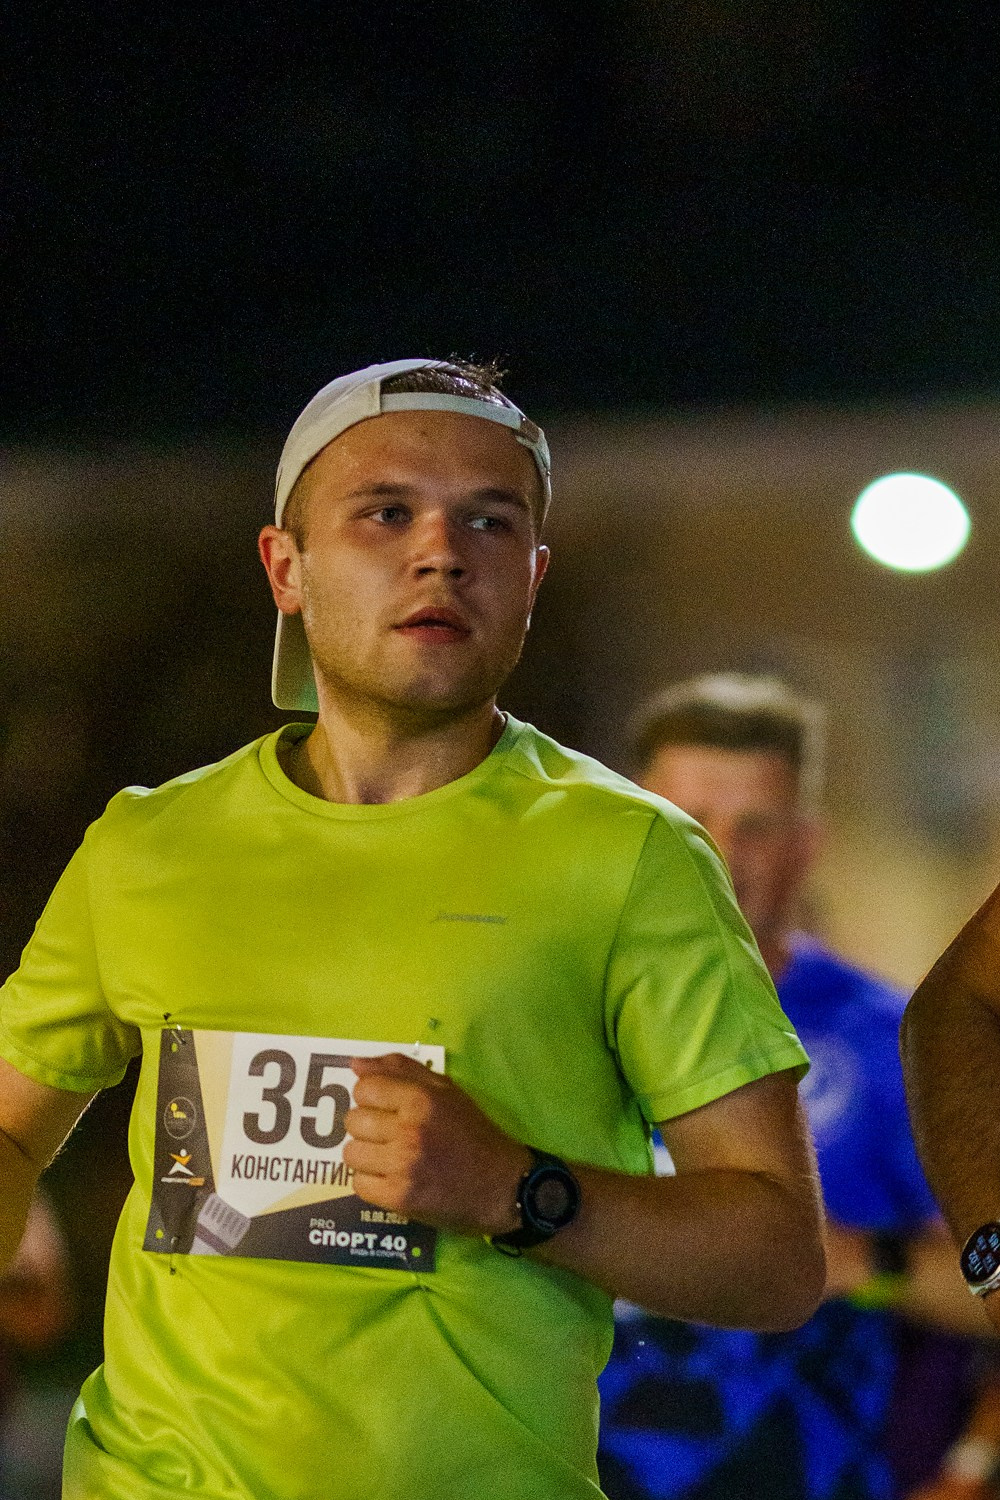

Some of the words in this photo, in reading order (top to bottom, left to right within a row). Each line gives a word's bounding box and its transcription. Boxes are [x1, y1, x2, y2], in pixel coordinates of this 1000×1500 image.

[309, 1218, 335, 1230] PRO
[308, 1229, 378, 1250] СПОРТ
[379, 1234, 407, 1252] 40
